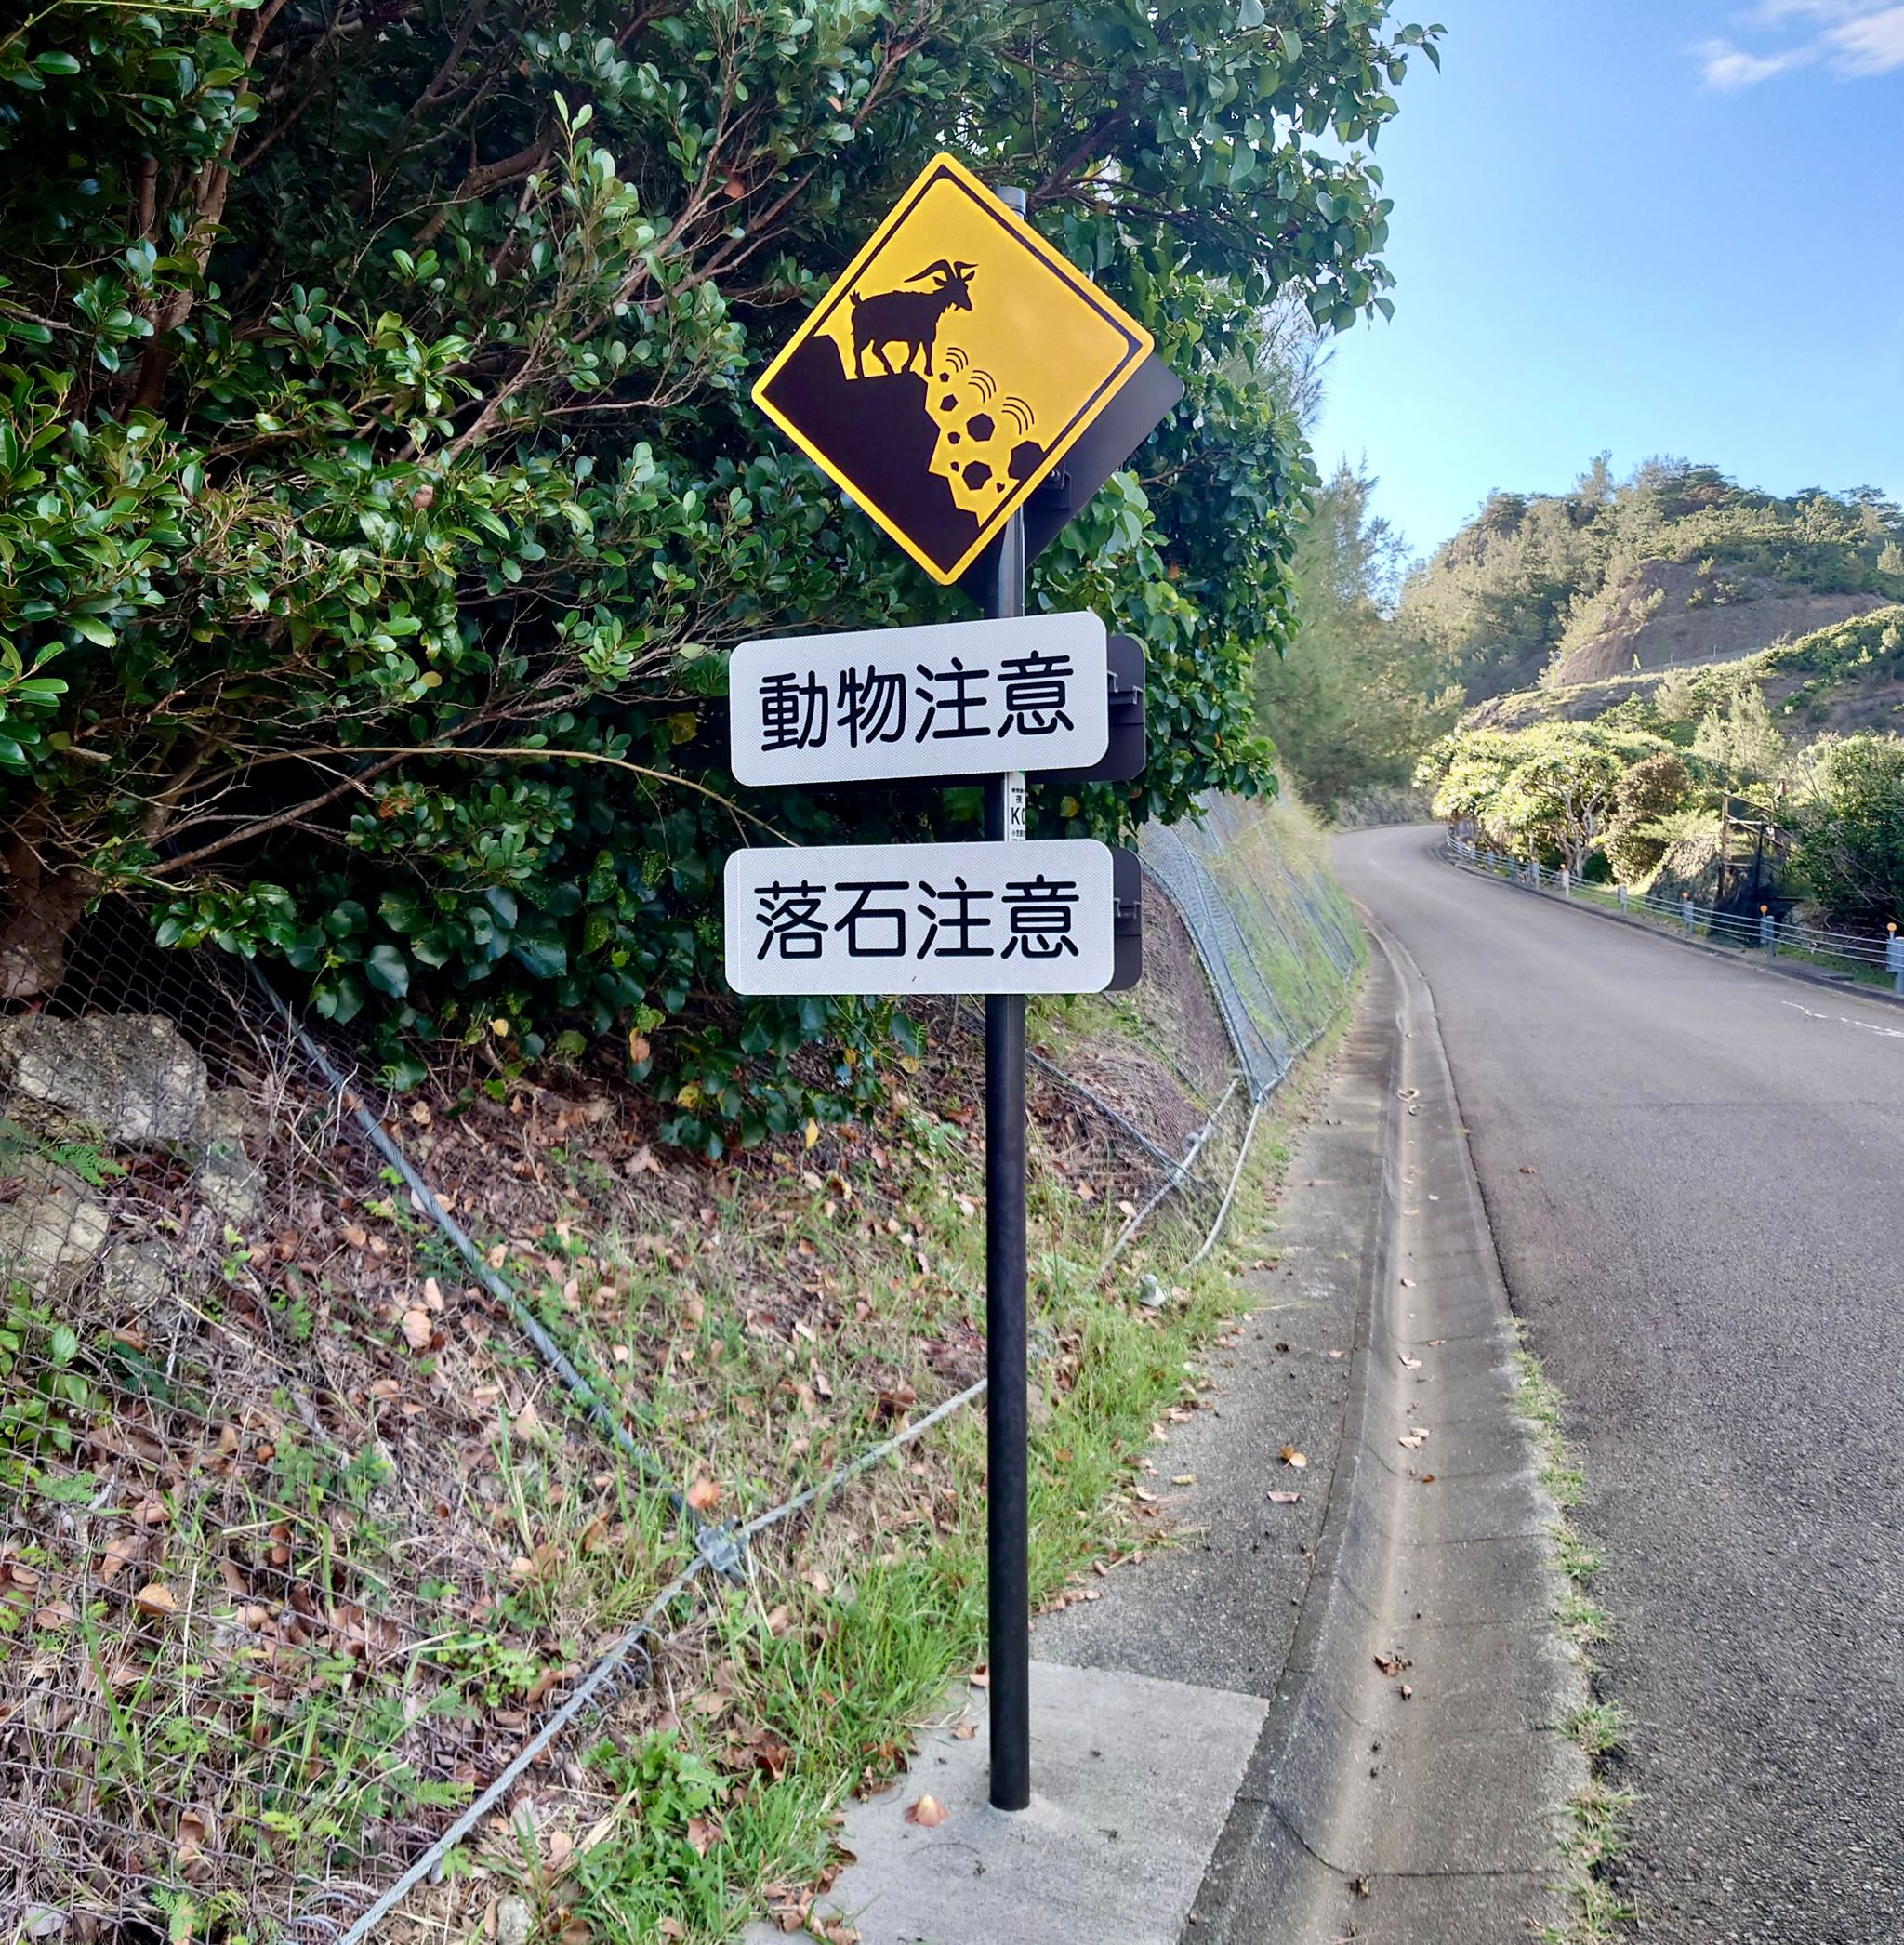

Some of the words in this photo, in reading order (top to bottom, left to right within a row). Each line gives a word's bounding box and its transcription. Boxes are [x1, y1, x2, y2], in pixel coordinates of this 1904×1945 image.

[760, 650, 1074, 751] 動物注意
[754, 875, 1079, 960] 落石注意
